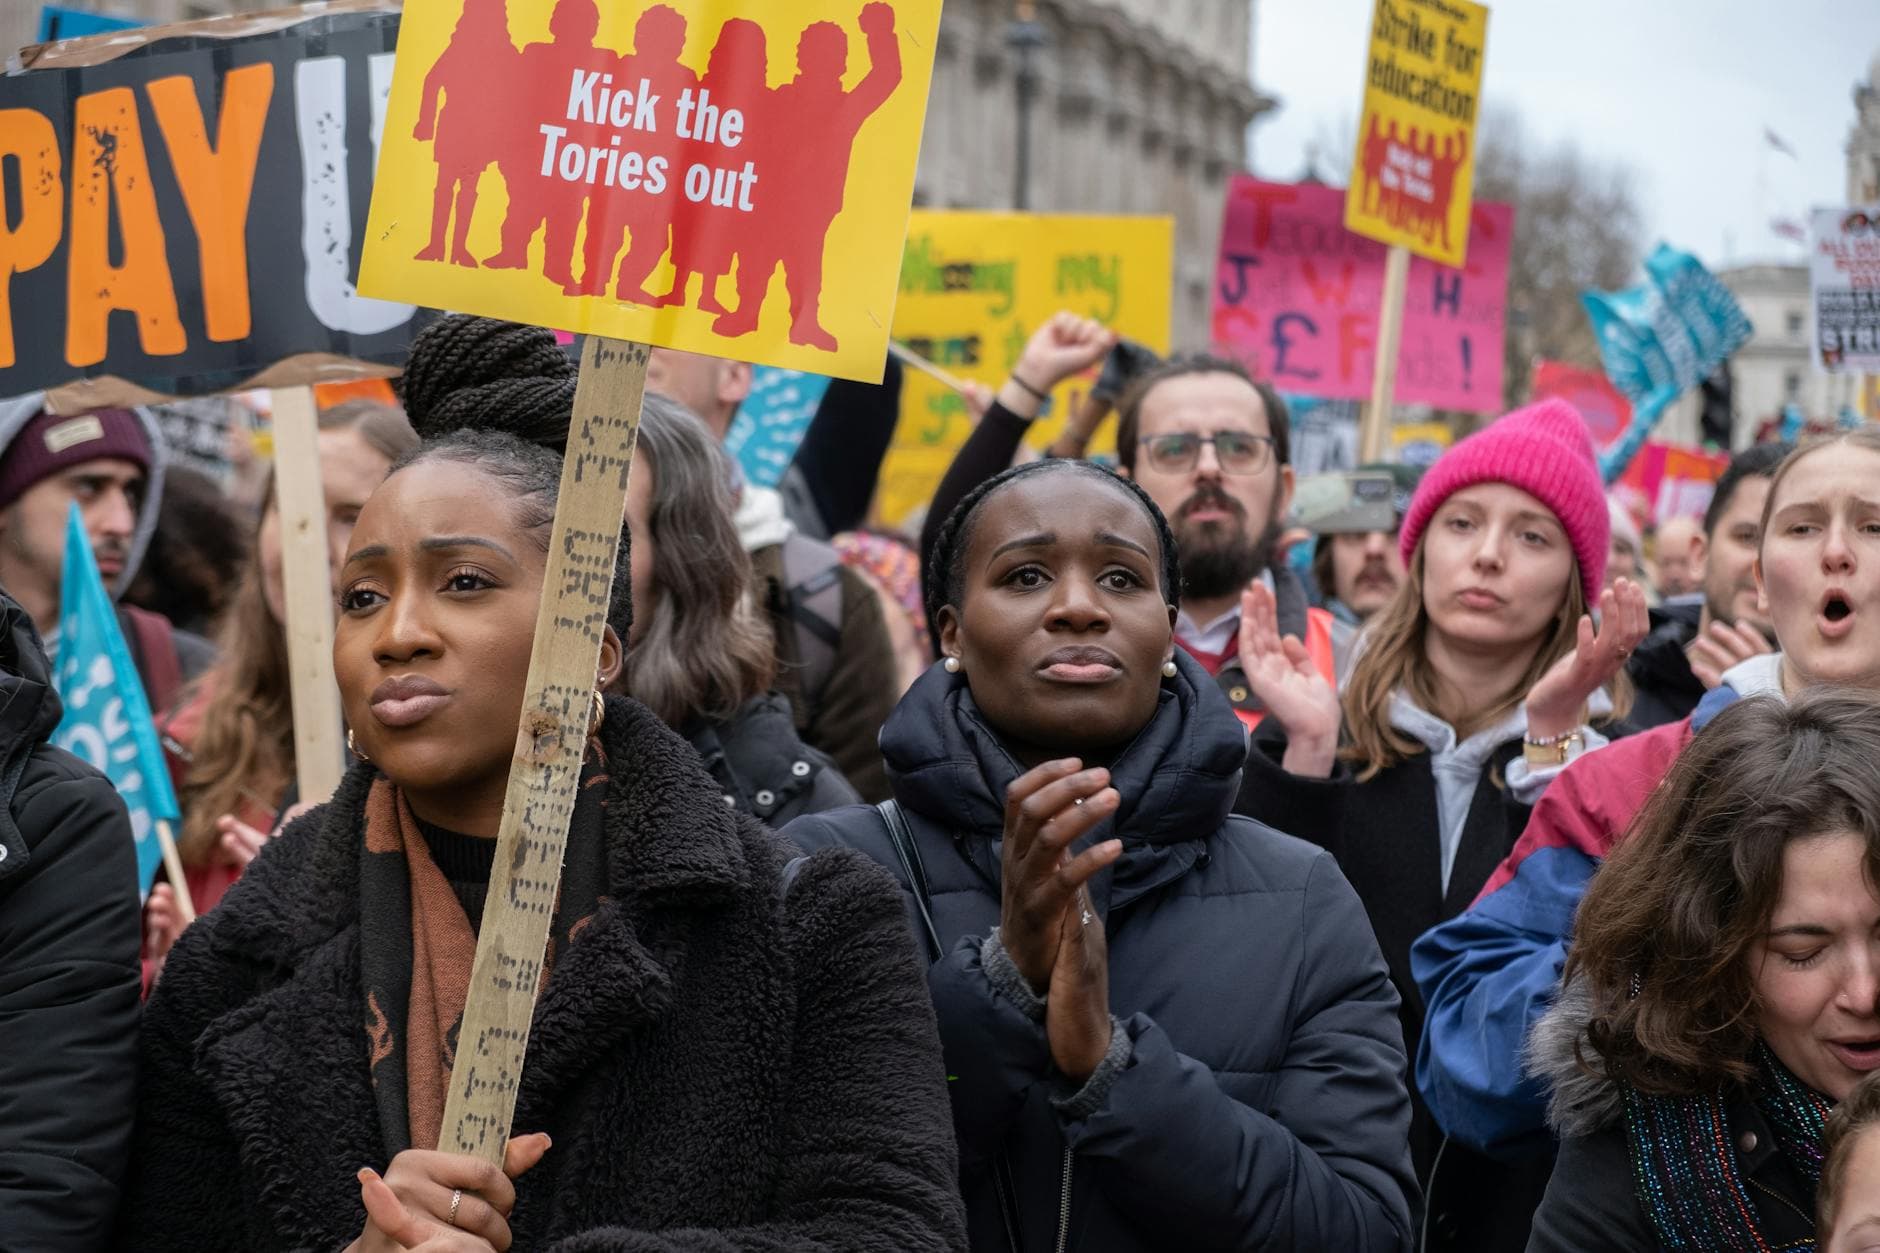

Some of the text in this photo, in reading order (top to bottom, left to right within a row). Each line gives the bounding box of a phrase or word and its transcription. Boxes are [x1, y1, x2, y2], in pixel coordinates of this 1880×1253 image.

[1376, 0, 1478, 75] Strike for
[566, 69, 744, 148] Kick the
[1368, 55, 1475, 122] education
[539, 123, 758, 212] Tories out
[0, 61, 274, 367] PAY
[1056, 254, 1122, 323] my
[574, 414, 636, 491] CE
[554, 527, 618, 646] DRY
[456, 1026, 528, 1155] C16
